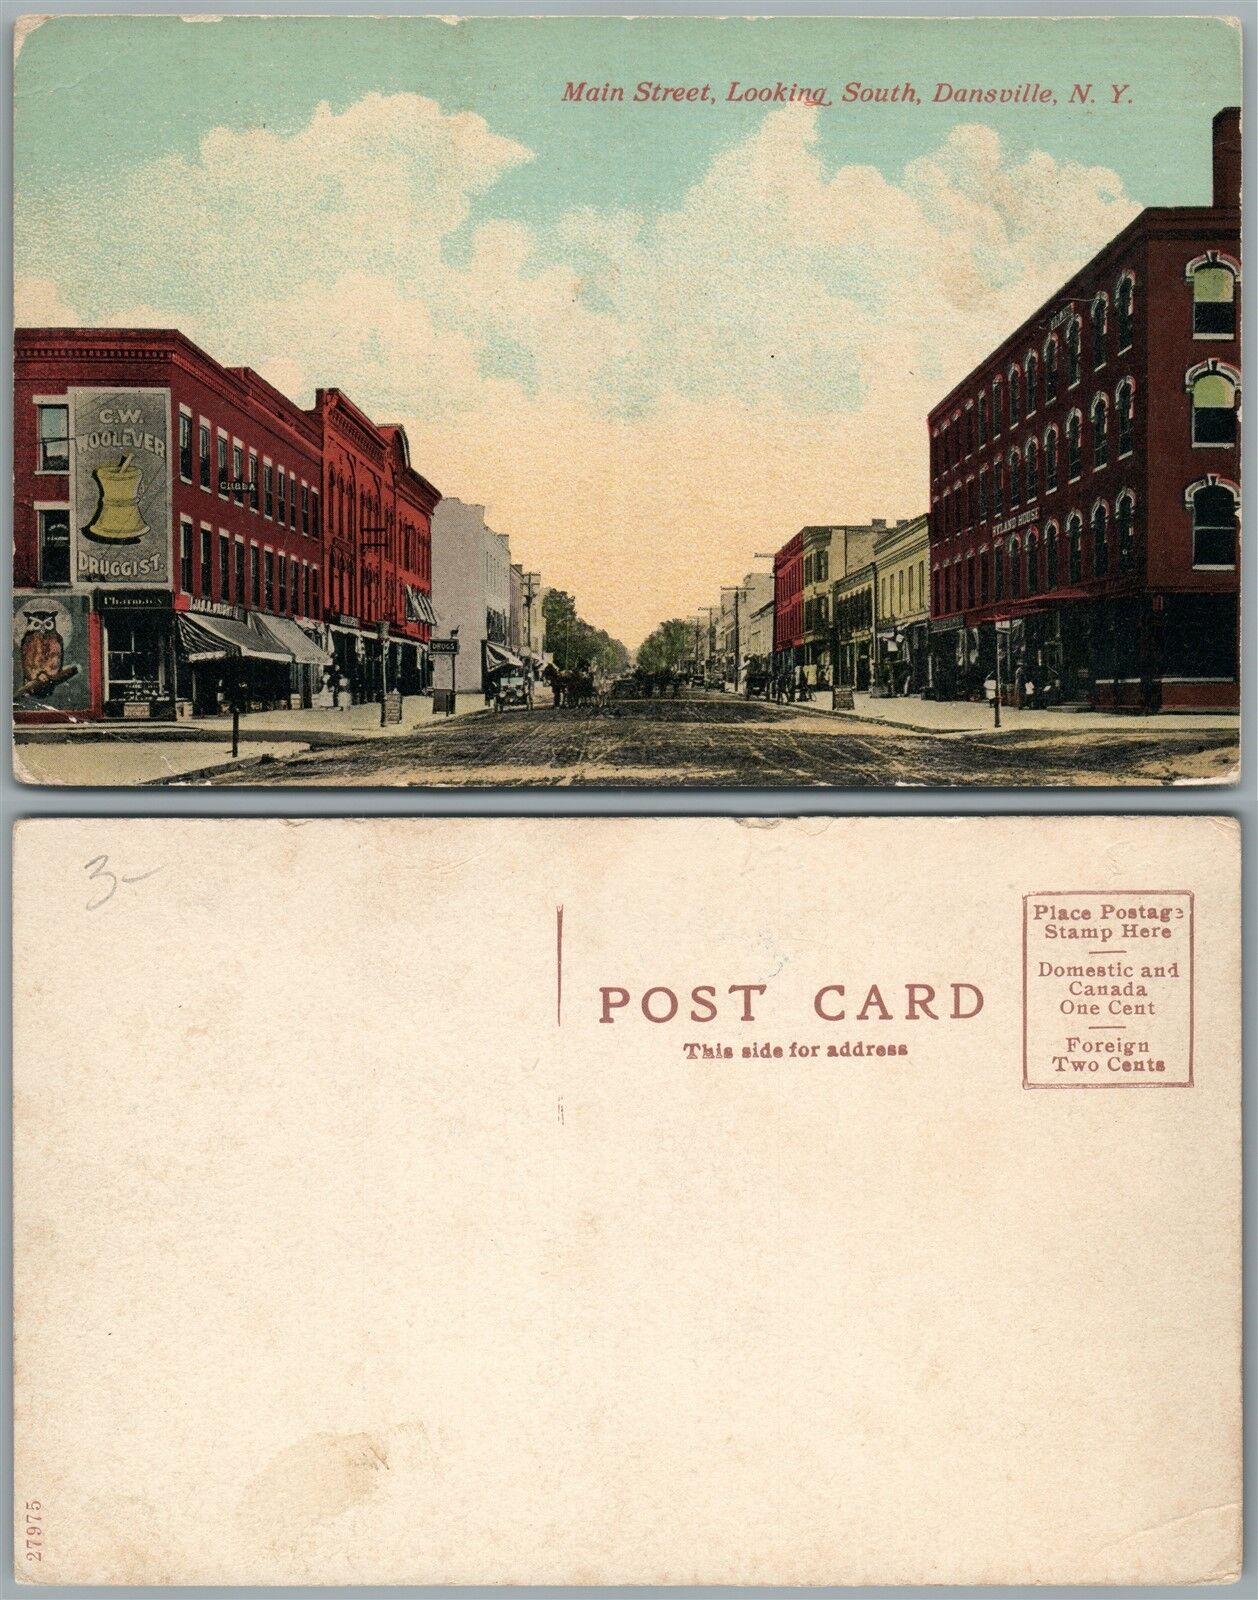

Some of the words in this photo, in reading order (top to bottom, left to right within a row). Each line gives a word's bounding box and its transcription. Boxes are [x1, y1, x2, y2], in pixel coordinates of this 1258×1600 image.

[562, 81, 624, 102] Main
[632, 81, 716, 105] Street,
[842, 81, 921, 106] South,
[932, 82, 1058, 105] Dansville,
[1069, 83, 1096, 104] N.
[1112, 83, 1134, 104] Y.
[78, 551, 165, 577] DRUGGIST.
[432, 642, 455, 651] DRUGS
[1033, 904, 1092, 921] Place
[1100, 904, 1184, 923] Postage
[1044, 923, 1113, 943] Stamp
[1121, 923, 1172, 939] Here
[1038, 961, 1134, 978] Domestic
[1140, 961, 1180, 978] and
[1068, 980, 1148, 997] Canada
[599, 983, 768, 1024] POST
[813, 982, 984, 1022] CARD
[1059, 999, 1101, 1016] One
[1108, 999, 1156, 1016] Cent
[683, 1042, 734, 1060] This
[741, 1041, 784, 1059] side
[788, 1041, 821, 1058] for
[826, 1040, 909, 1058] address
[1065, 1036, 1150, 1056] Foreign
[1051, 1055, 1100, 1073] Two
[1107, 1056, 1166, 1073] Cents
[26, 1500, 42, 1562] 27975
